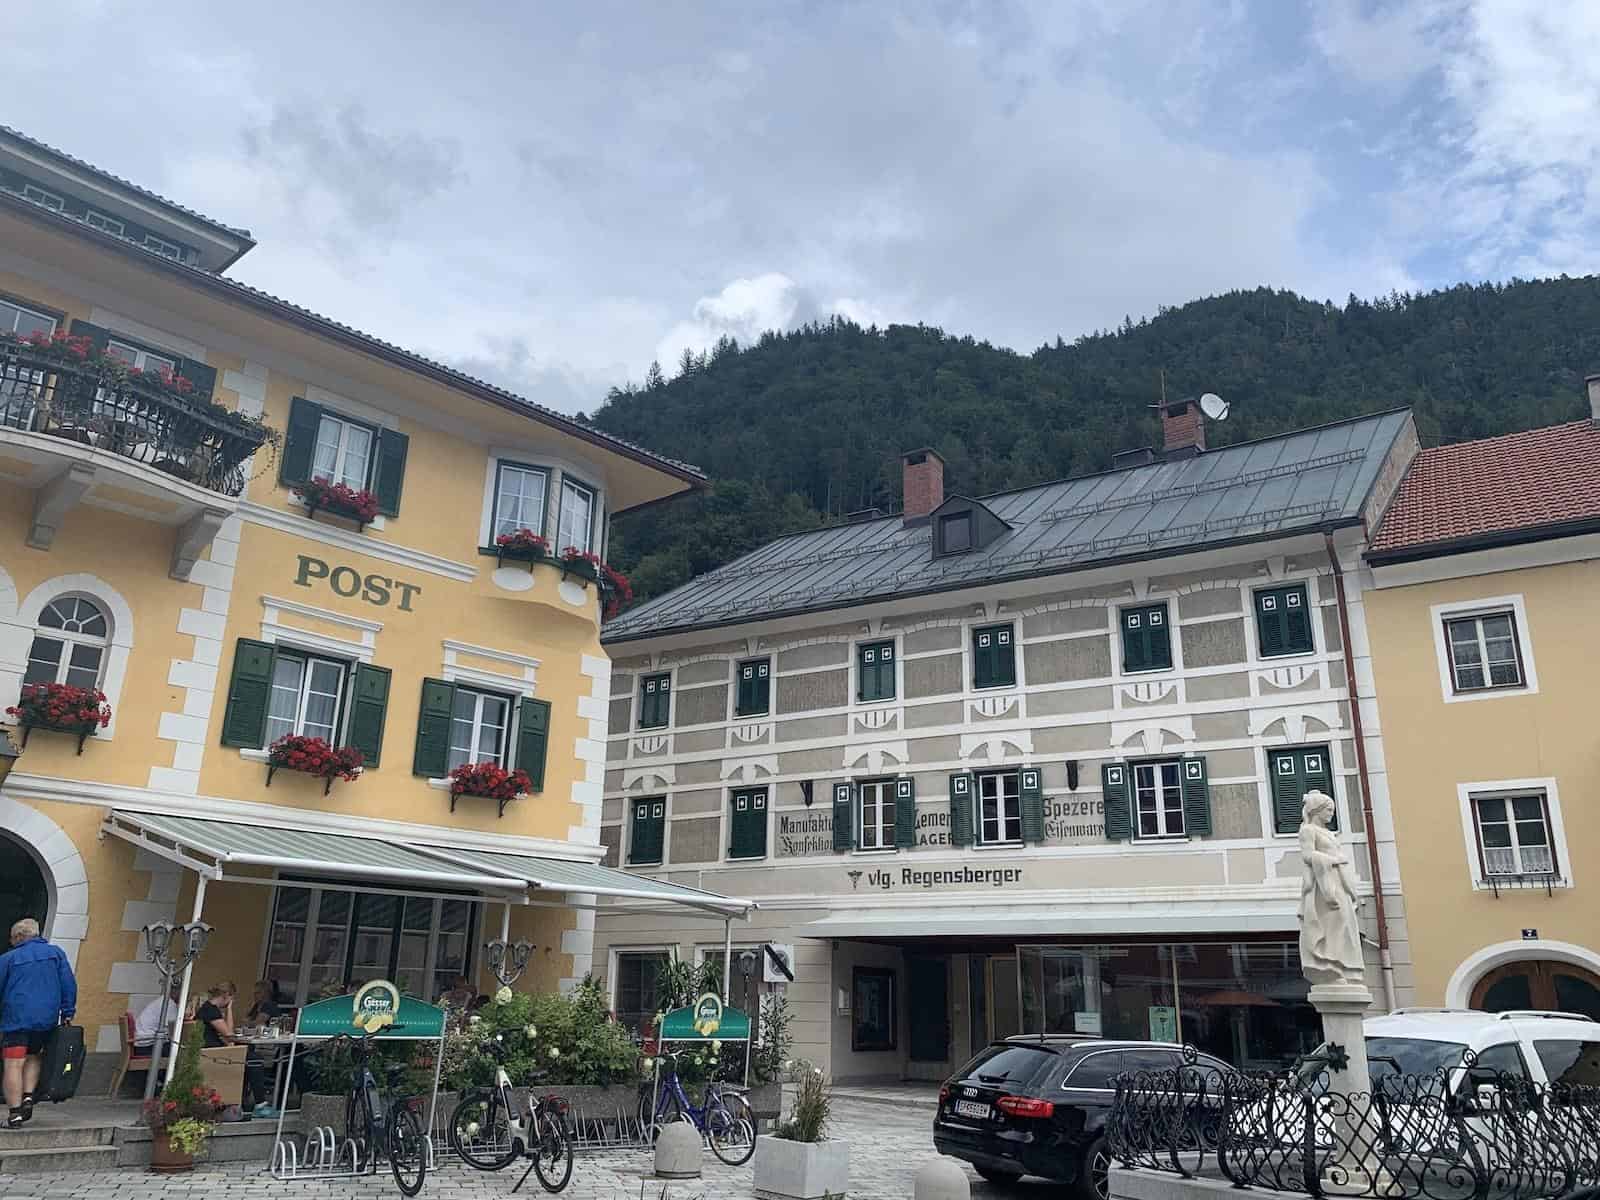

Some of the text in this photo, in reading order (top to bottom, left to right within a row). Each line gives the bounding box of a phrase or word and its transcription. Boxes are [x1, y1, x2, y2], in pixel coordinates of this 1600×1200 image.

[293, 554, 422, 612] POST
[868, 866, 1023, 889] vlg. Regensberger
